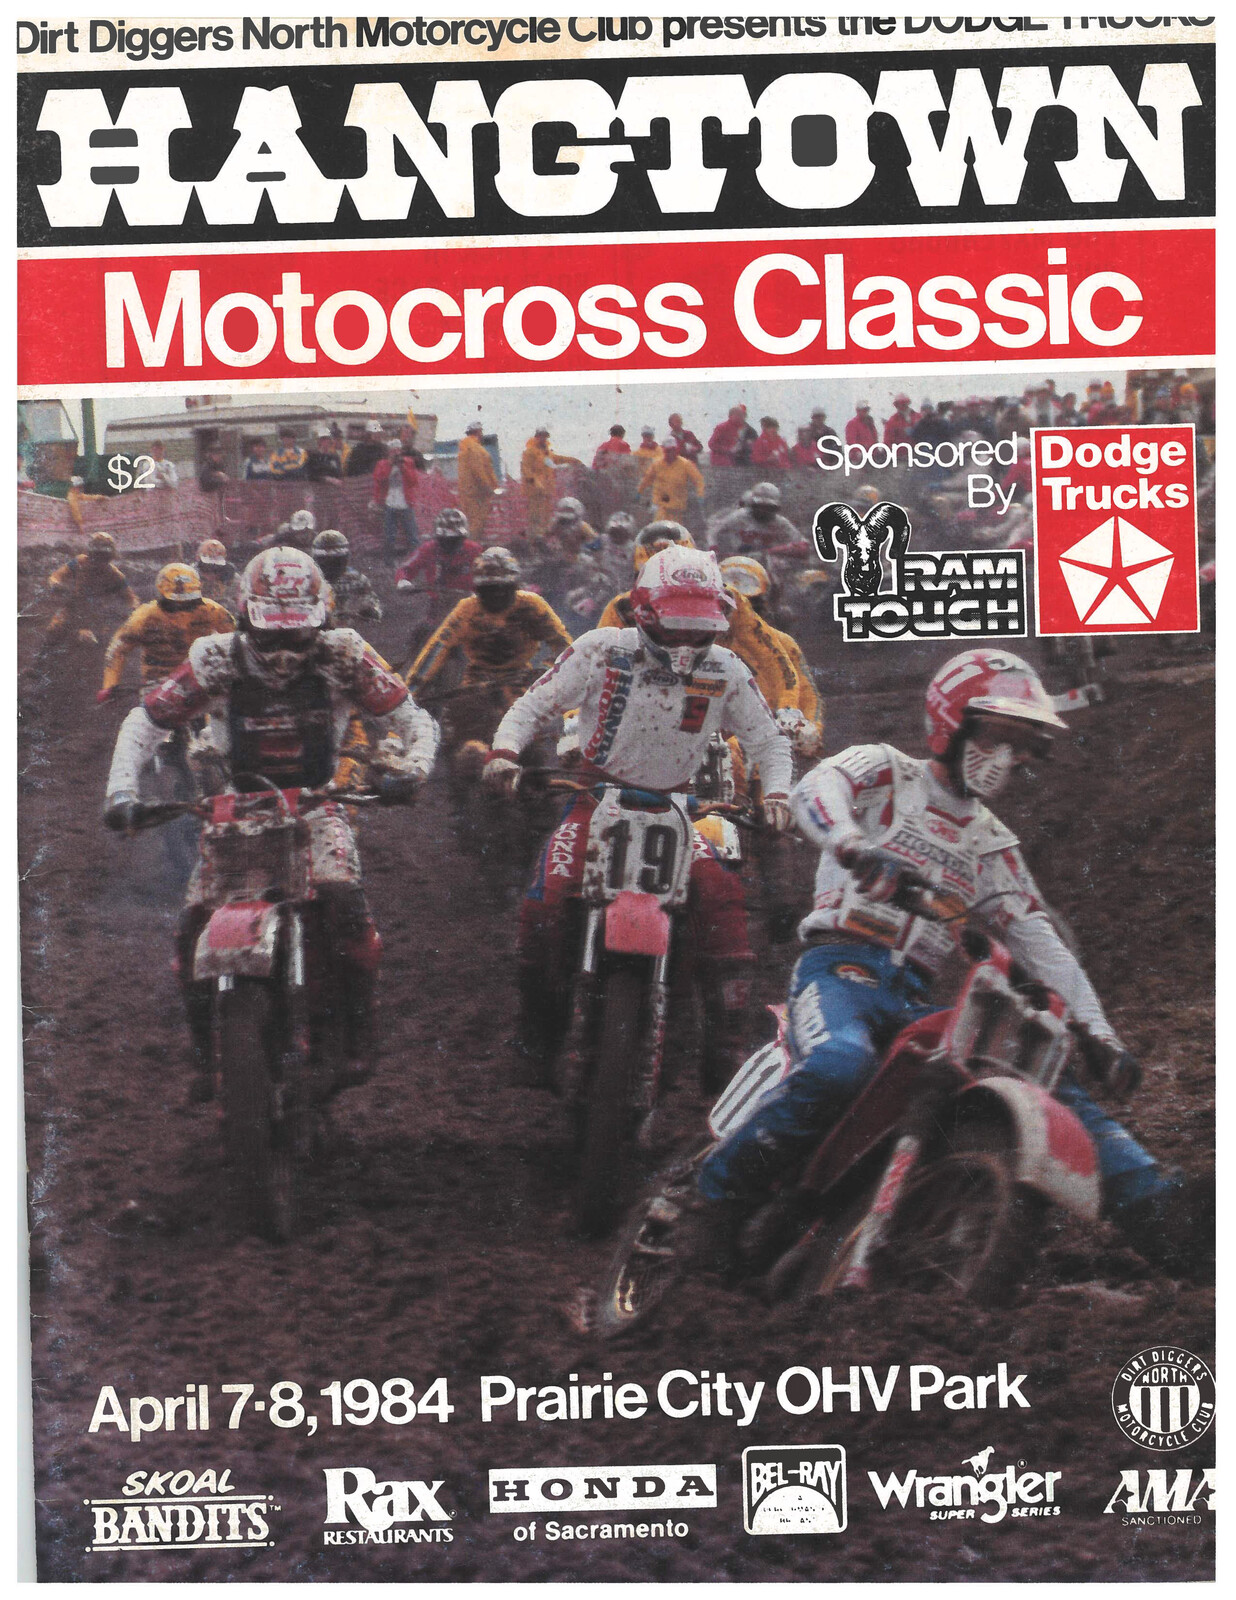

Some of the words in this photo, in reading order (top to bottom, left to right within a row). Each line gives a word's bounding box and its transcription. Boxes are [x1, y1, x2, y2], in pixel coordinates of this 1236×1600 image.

[17, 20, 79, 54] Dirt
[90, 19, 234, 61] Diggers
[242, 17, 348, 50] North
[356, 17, 561, 51] Motorcycle
[568, 17, 653, 42] Club
[663, 17, 826, 48] presents
[838, 17, 897, 36] the
[36, 62, 1202, 228] HANGTOWN
[104, 269, 707, 368] Motocross
[734, 247, 1144, 355] Classic
[107, 453, 156, 492] $2
[816, 431, 1018, 477] Sponsored
[1041, 434, 1187, 474] Dodge
[967, 473, 1017, 515] By
[1042, 477, 1189, 510] Trucks
[904, 558, 1018, 592] RAM
[844, 599, 1020, 633] TOUGH
[549, 822, 581, 877] HONDA
[603, 819, 677, 894] 19
[1121, 1356, 1147, 1382] DIRT
[1152, 1350, 1208, 1381] DIGGERS
[1142, 1367, 1188, 1384] NORTH
[88, 1384, 210, 1442] April
[480, 1372, 648, 1422] Prairie
[657, 1369, 766, 1426] City
[776, 1365, 900, 1415] OHV
[910, 1362, 1031, 1412] Park
[1116, 1403, 1189, 1447] MOTORCYCLE
[1191, 1402, 1214, 1433] CLUB
[122, 1468, 236, 1496] SKOAL
[322, 1466, 453, 1532] Rax
[492, 1475, 714, 1502] HONDA
[751, 1461, 841, 1507] BEL-RAY
[867, 1465, 1062, 1524] Wrangler
[1103, 1469, 1216, 1513] AMA
[91, 1502, 270, 1544] BANDITS
[513, 1521, 536, 1541] of
[545, 1519, 689, 1541] Sacramento
[929, 1509, 975, 1520] SUPER
[1011, 1506, 1061, 1517] SERIES
[1121, 1515, 1202, 1526] SANCTIONED
[323, 1528, 454, 1545] RESTAURANTS
